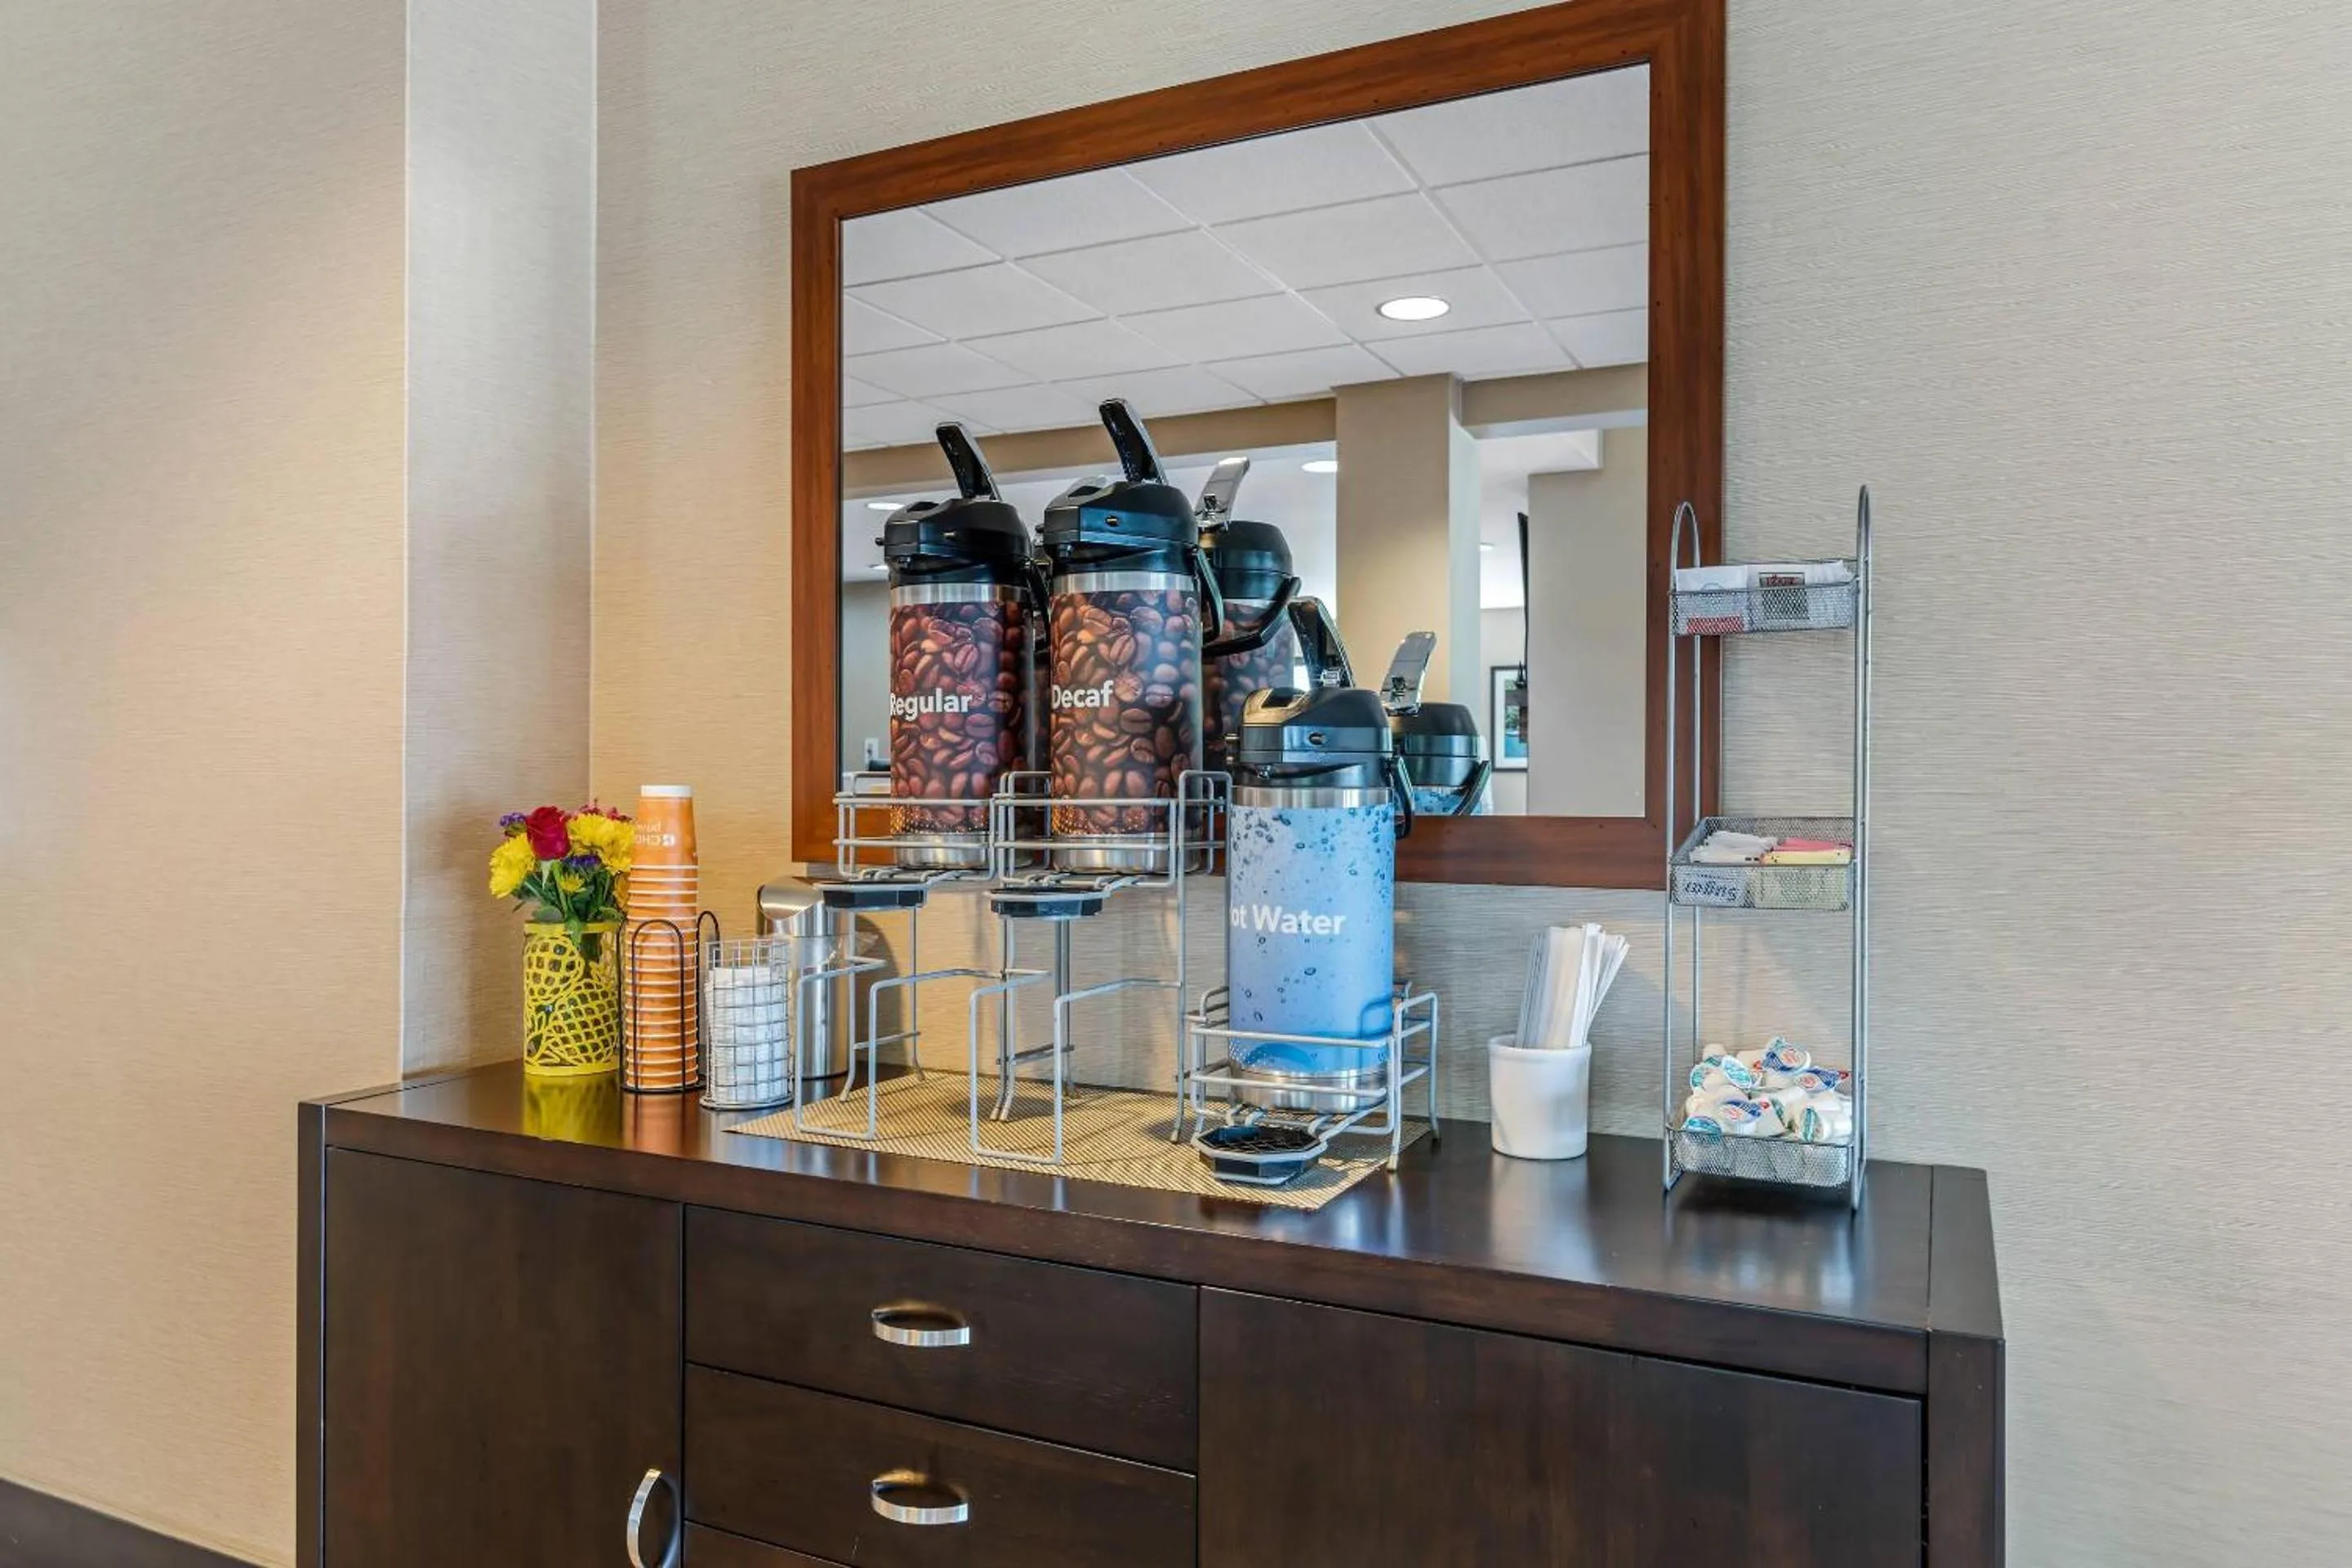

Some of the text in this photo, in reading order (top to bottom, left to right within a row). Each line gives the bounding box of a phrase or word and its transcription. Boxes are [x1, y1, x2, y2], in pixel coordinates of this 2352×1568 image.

[890, 688, 973, 721] Regular
[1051, 679, 1114, 709] Decaf
[1230, 903, 1347, 935] ot Water
